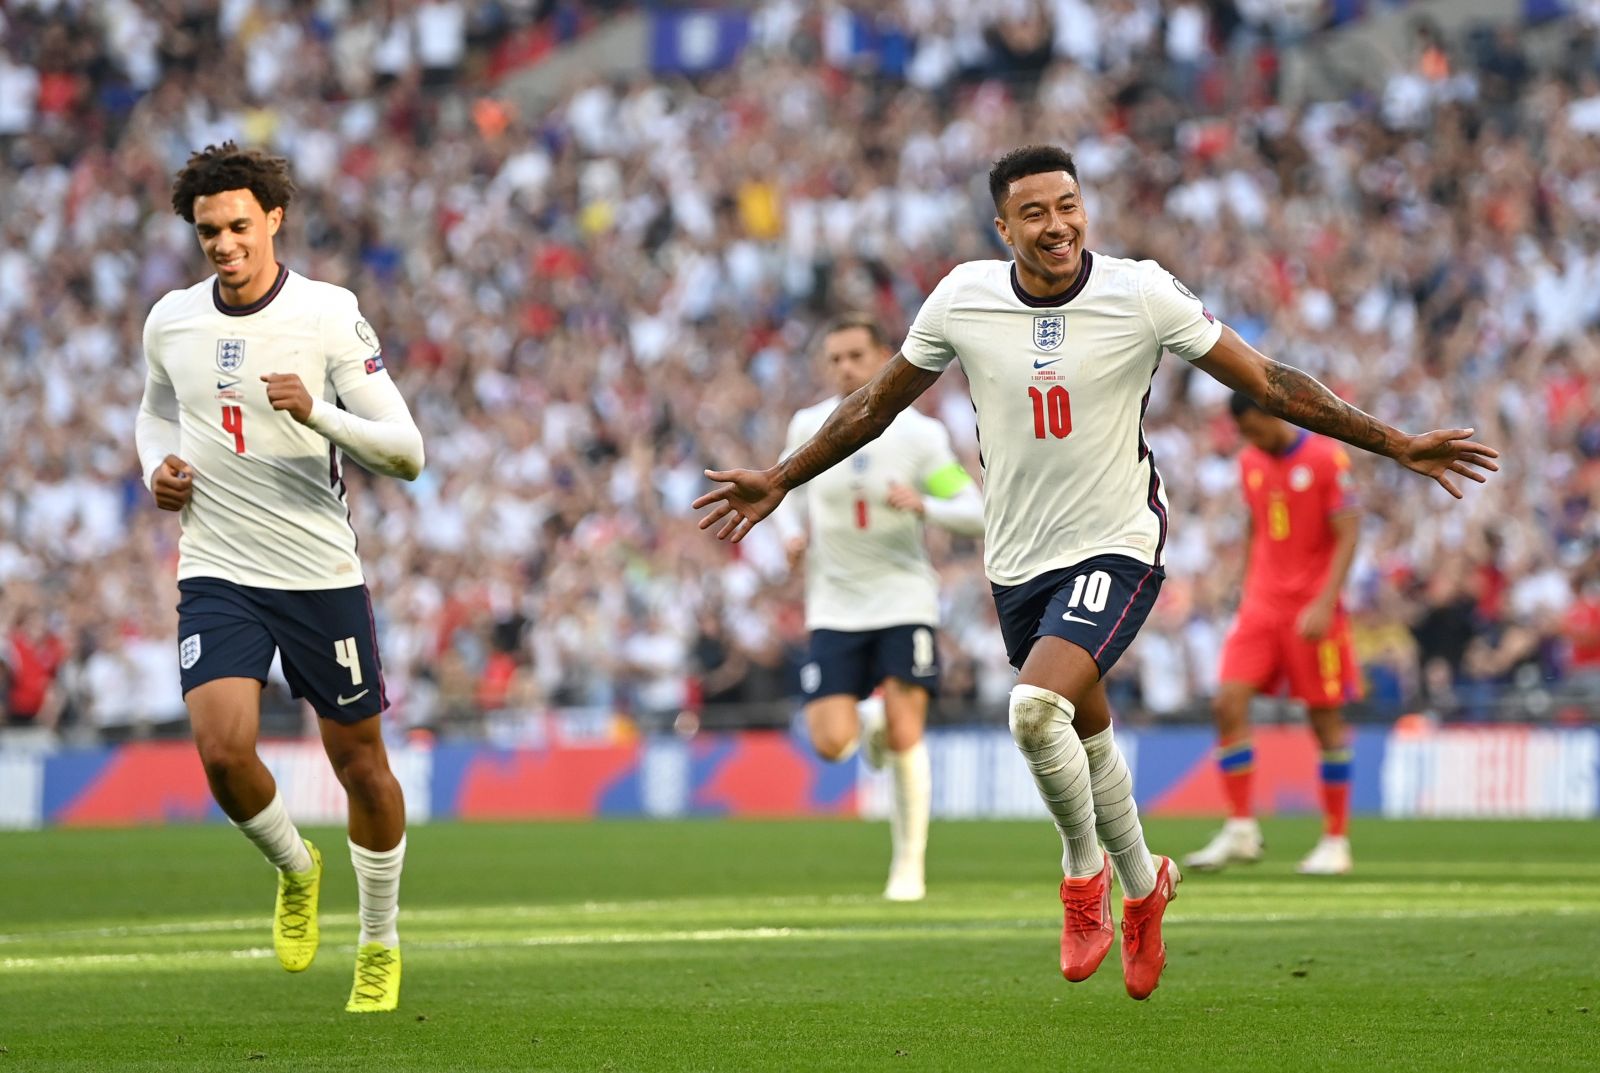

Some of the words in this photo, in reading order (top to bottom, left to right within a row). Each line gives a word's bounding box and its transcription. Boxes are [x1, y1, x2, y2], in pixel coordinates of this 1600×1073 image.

[221, 405, 246, 454] 4
[1028, 385, 1073, 439] 10
[1067, 570, 1112, 613] 10
[334, 636, 363, 686] 4
